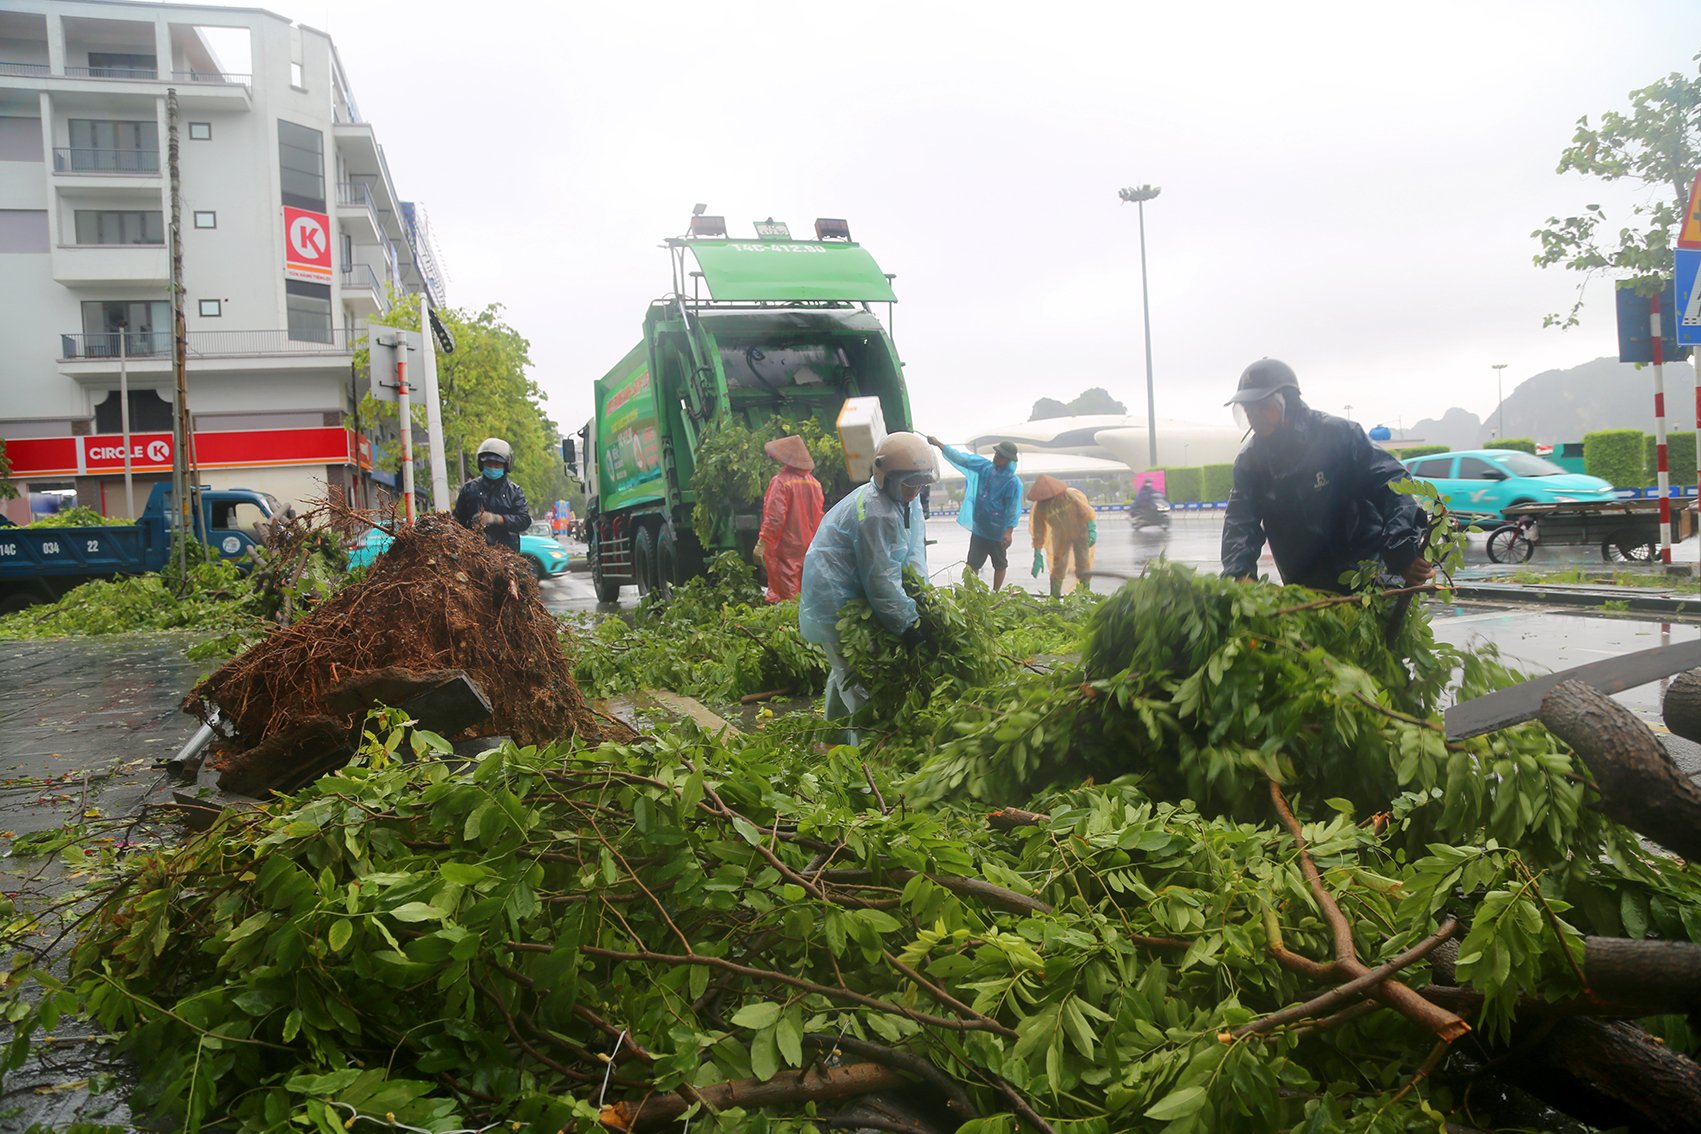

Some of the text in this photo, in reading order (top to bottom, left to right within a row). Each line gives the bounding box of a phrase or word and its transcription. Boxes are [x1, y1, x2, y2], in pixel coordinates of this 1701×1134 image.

[296, 221, 325, 257] K
[151, 444, 169, 461] K
[0, 540, 99, 556] 14C 034 22
